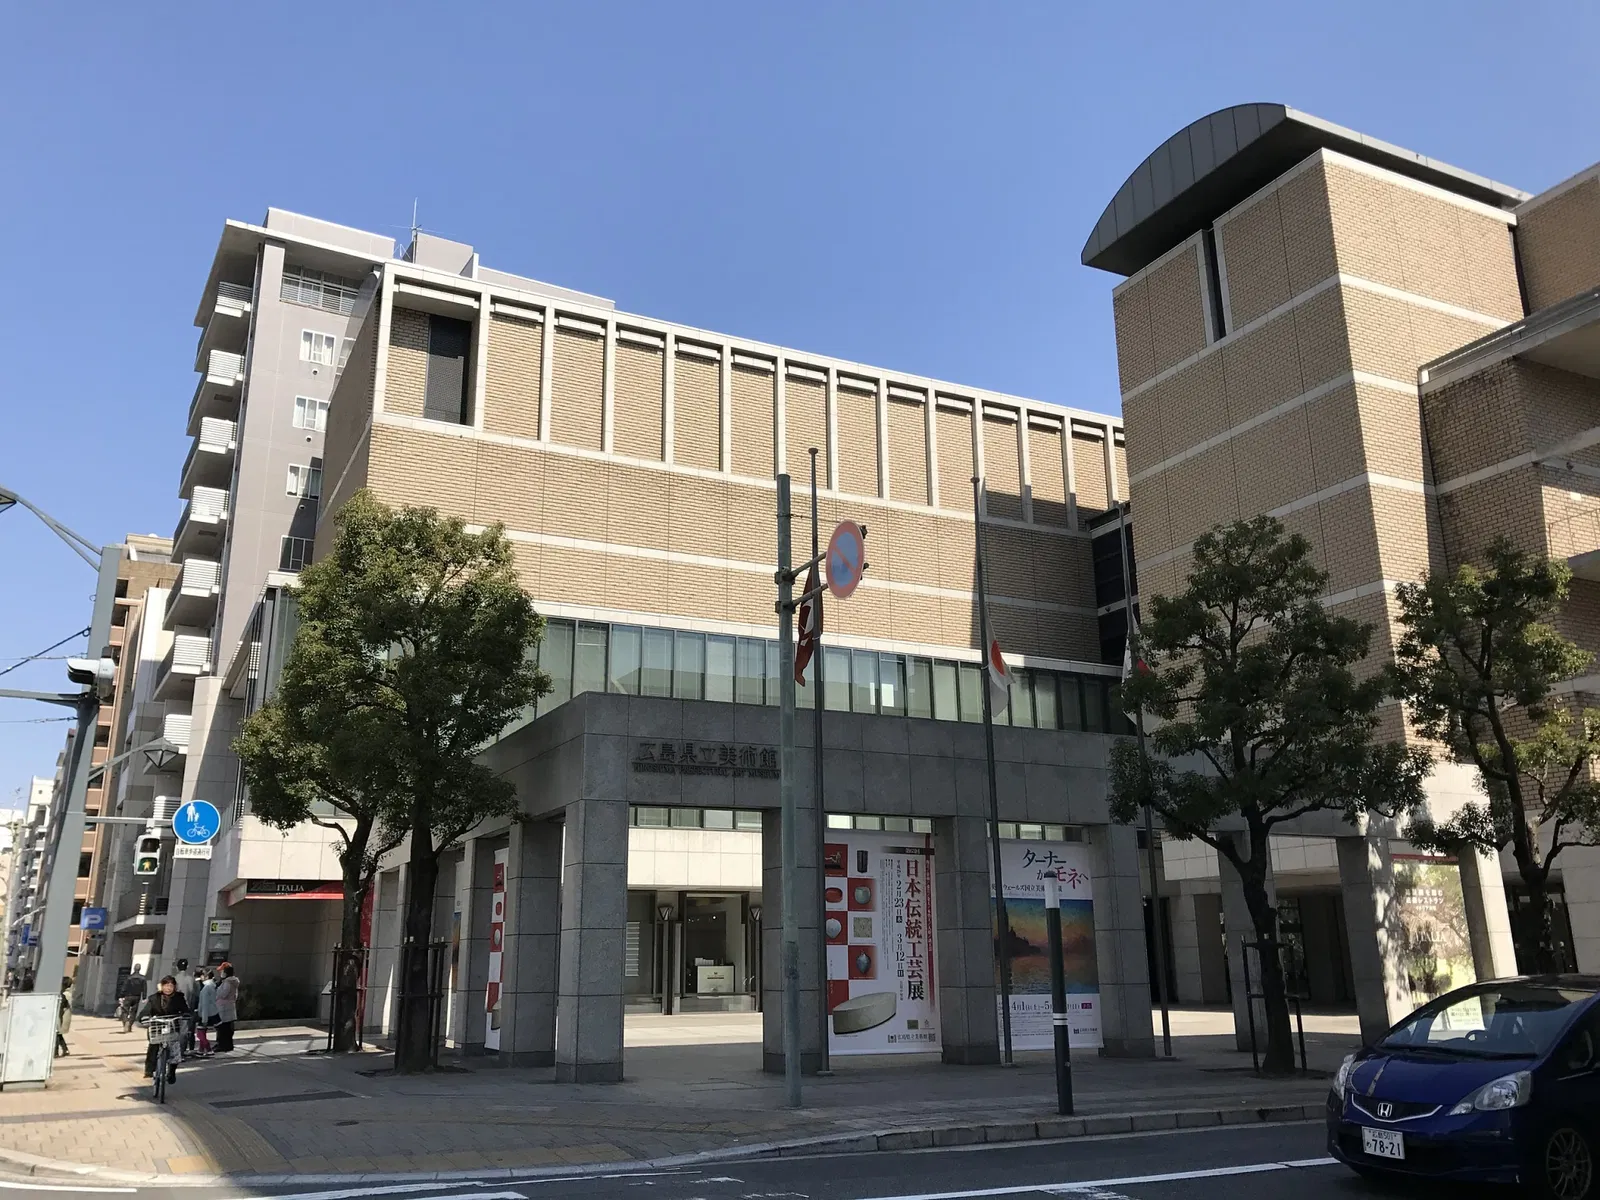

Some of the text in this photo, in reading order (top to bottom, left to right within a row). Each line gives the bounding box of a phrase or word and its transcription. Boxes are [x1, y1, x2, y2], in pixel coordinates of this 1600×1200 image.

[635, 742, 778, 768] 広島県立美術館
[1022, 847, 1067, 869] ターナー
[275, 884, 305, 892] ITALIA
[1036, 866, 1089, 890] かモネへ
[85, 914, 102, 927] P
[904, 858, 924, 1001] 日本伝統工芸展
[1371, 1139, 1401, 1157] 78-21
